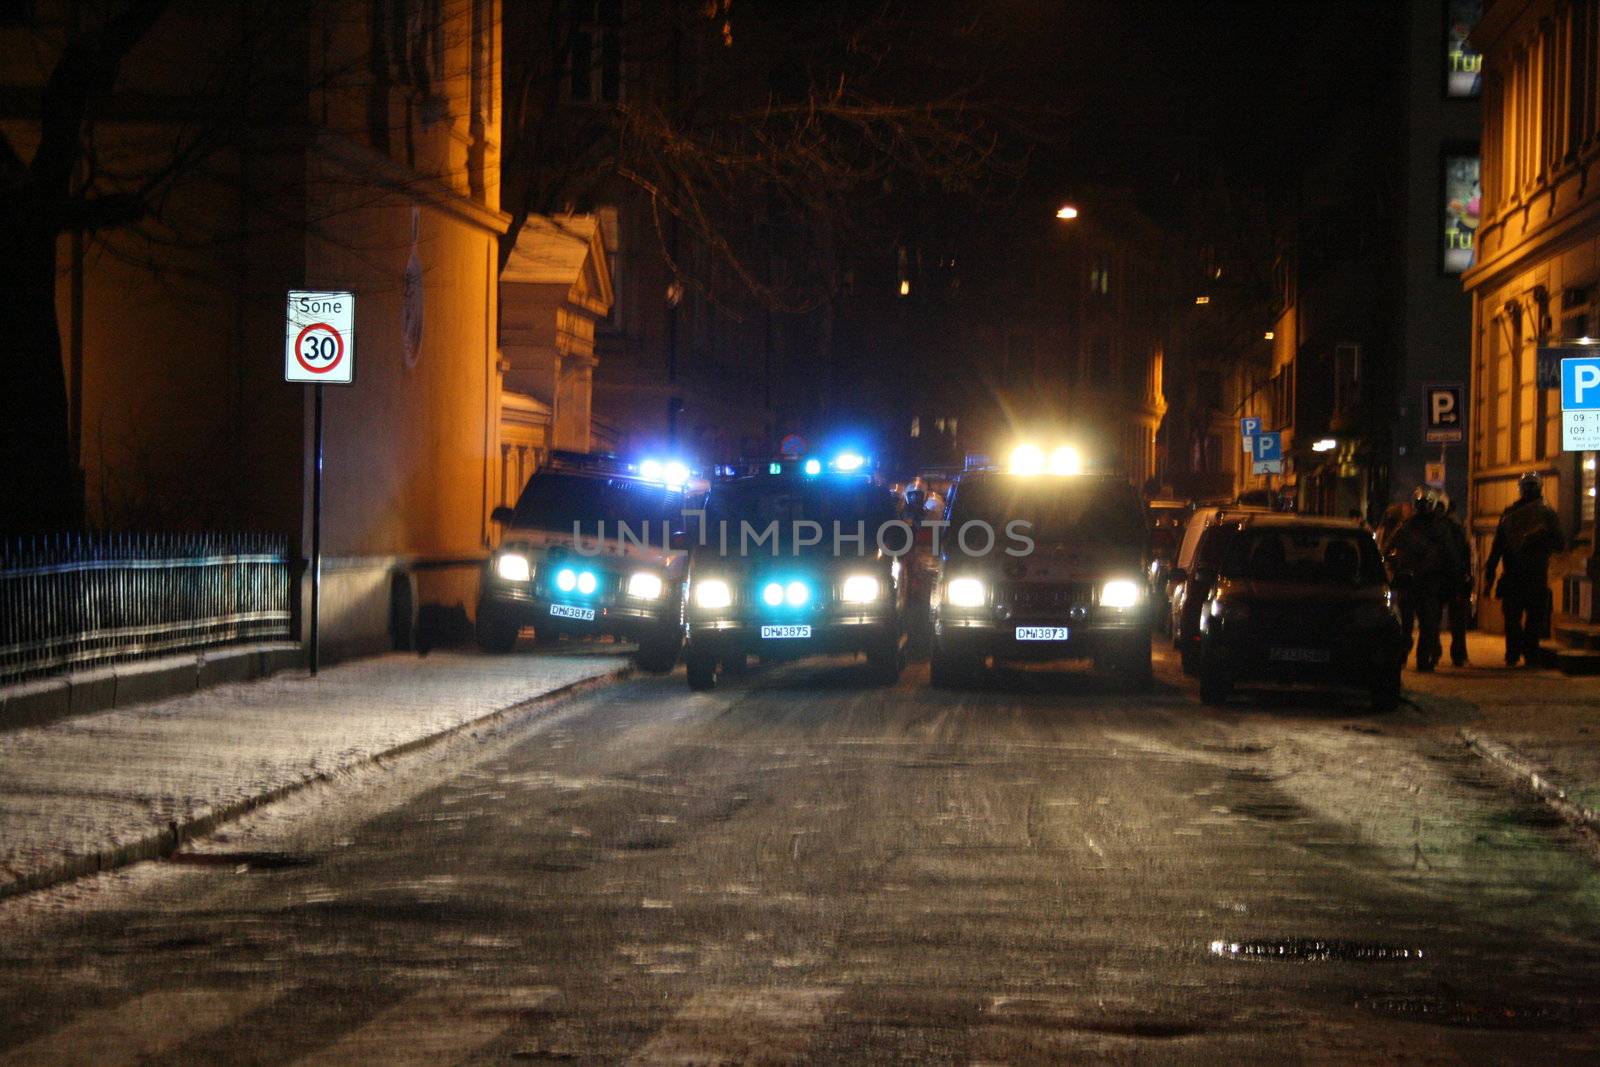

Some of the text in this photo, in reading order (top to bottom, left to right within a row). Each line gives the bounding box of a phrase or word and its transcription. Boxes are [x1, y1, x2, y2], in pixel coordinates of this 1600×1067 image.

[300, 297, 343, 313] Sone
[304, 336, 336, 361] 30
[1574, 365, 1600, 403] P
[1432, 391, 1455, 425] P
[1246, 420, 1256, 436] P
[1259, 437, 1274, 458] P
